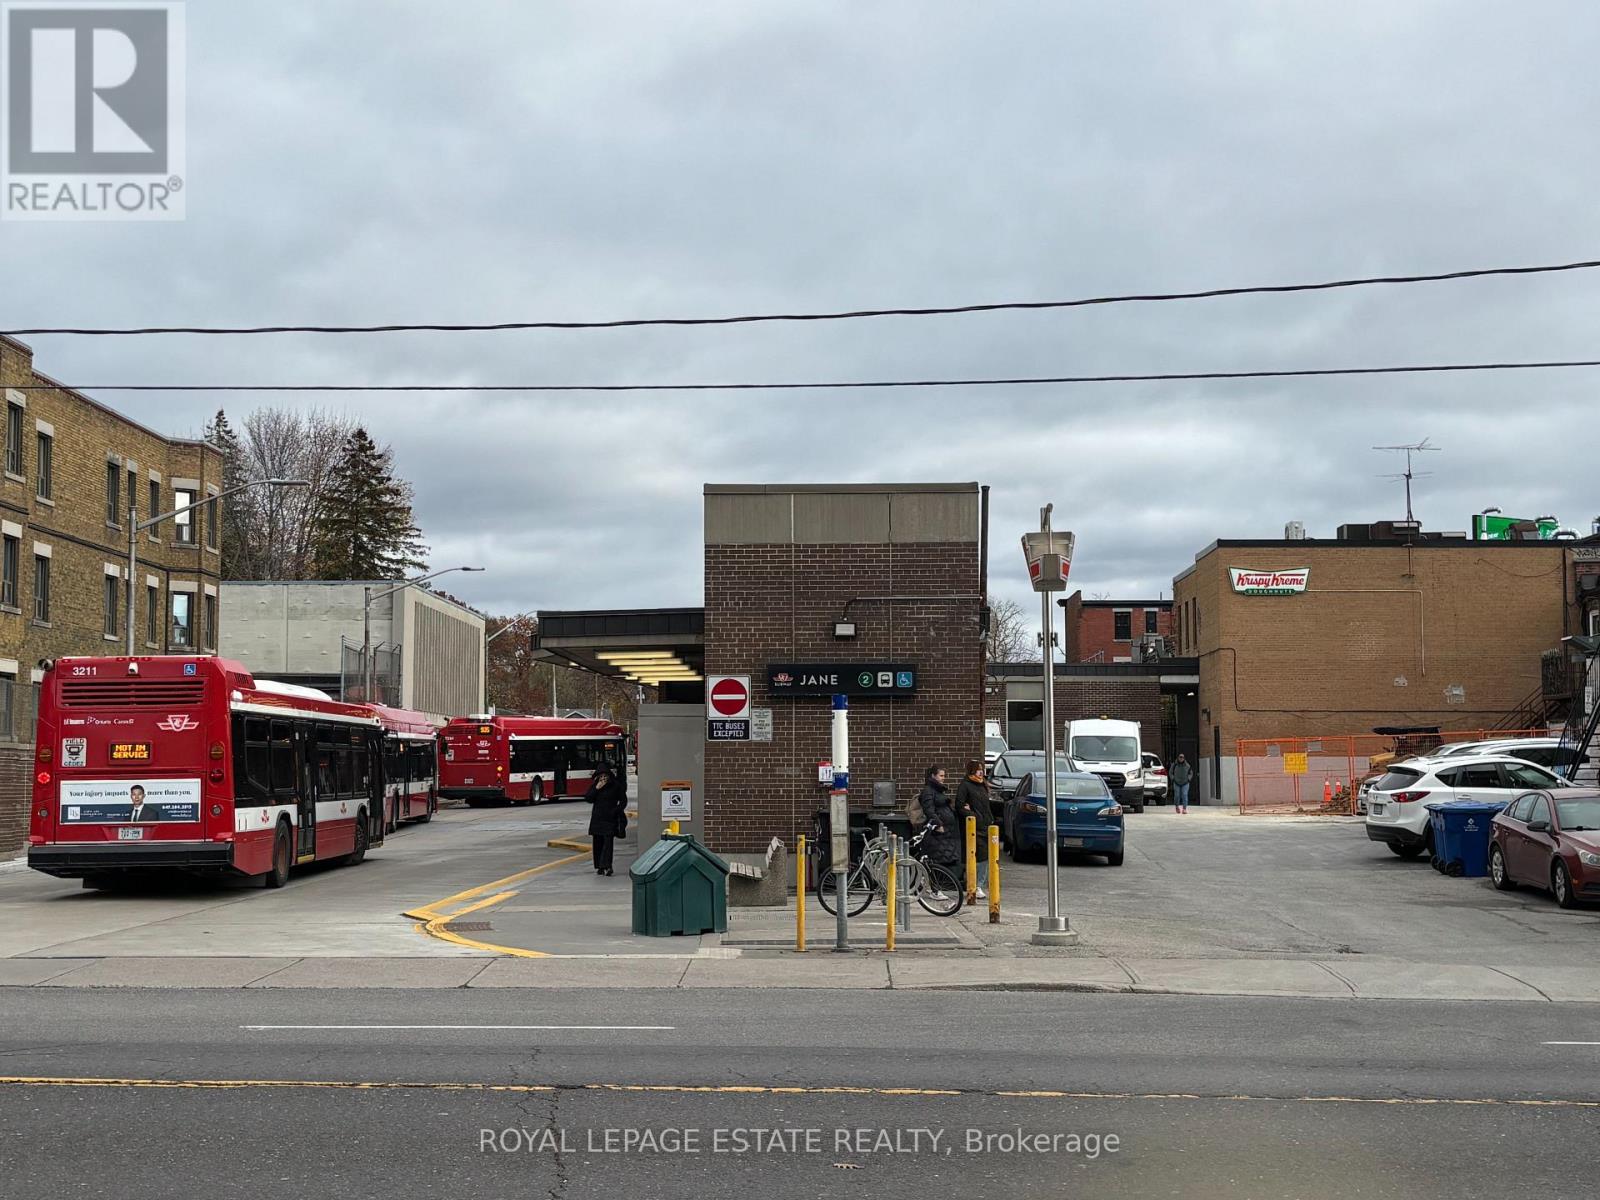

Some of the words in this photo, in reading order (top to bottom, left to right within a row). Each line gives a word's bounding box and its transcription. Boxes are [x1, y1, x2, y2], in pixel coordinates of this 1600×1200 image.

[1236, 573, 1271, 588] Krispy
[1271, 573, 1306, 586] Kreme
[72, 666, 97, 676] 3211
[800, 674, 839, 686] JANE
[862, 675, 870, 684] 2
[712, 722, 724, 730] TTC
[725, 722, 745, 730] BUSES
[713, 730, 744, 738] EXCEPTED
[115, 744, 132, 752] NOT
[136, 744, 146, 752] IN
[112, 751, 149, 759] SERVICE
[85, 790, 103, 798] injury
